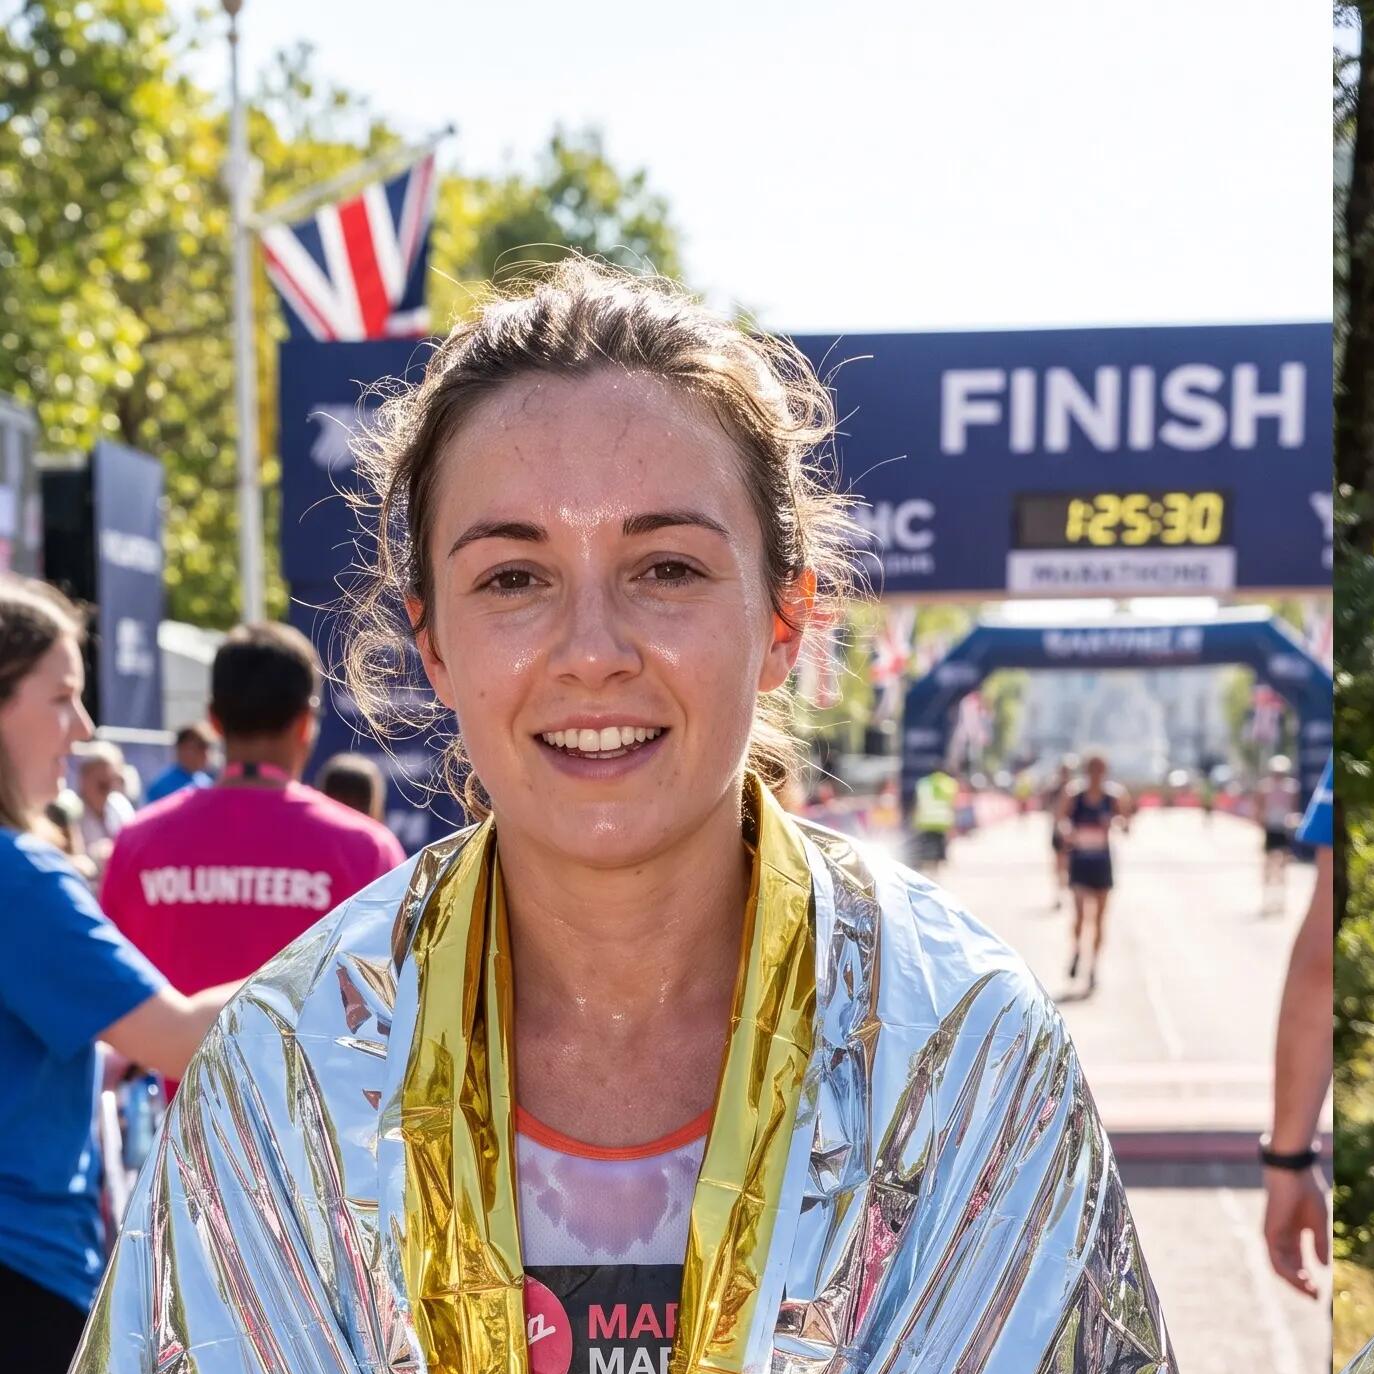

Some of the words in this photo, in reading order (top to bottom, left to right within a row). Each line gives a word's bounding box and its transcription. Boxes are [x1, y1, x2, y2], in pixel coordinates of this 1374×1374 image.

[940, 362, 1306, 454] FINISH
[1065, 492, 1224, 545] 1:25:30
[139, 865, 332, 910] VOLUNTEERS
